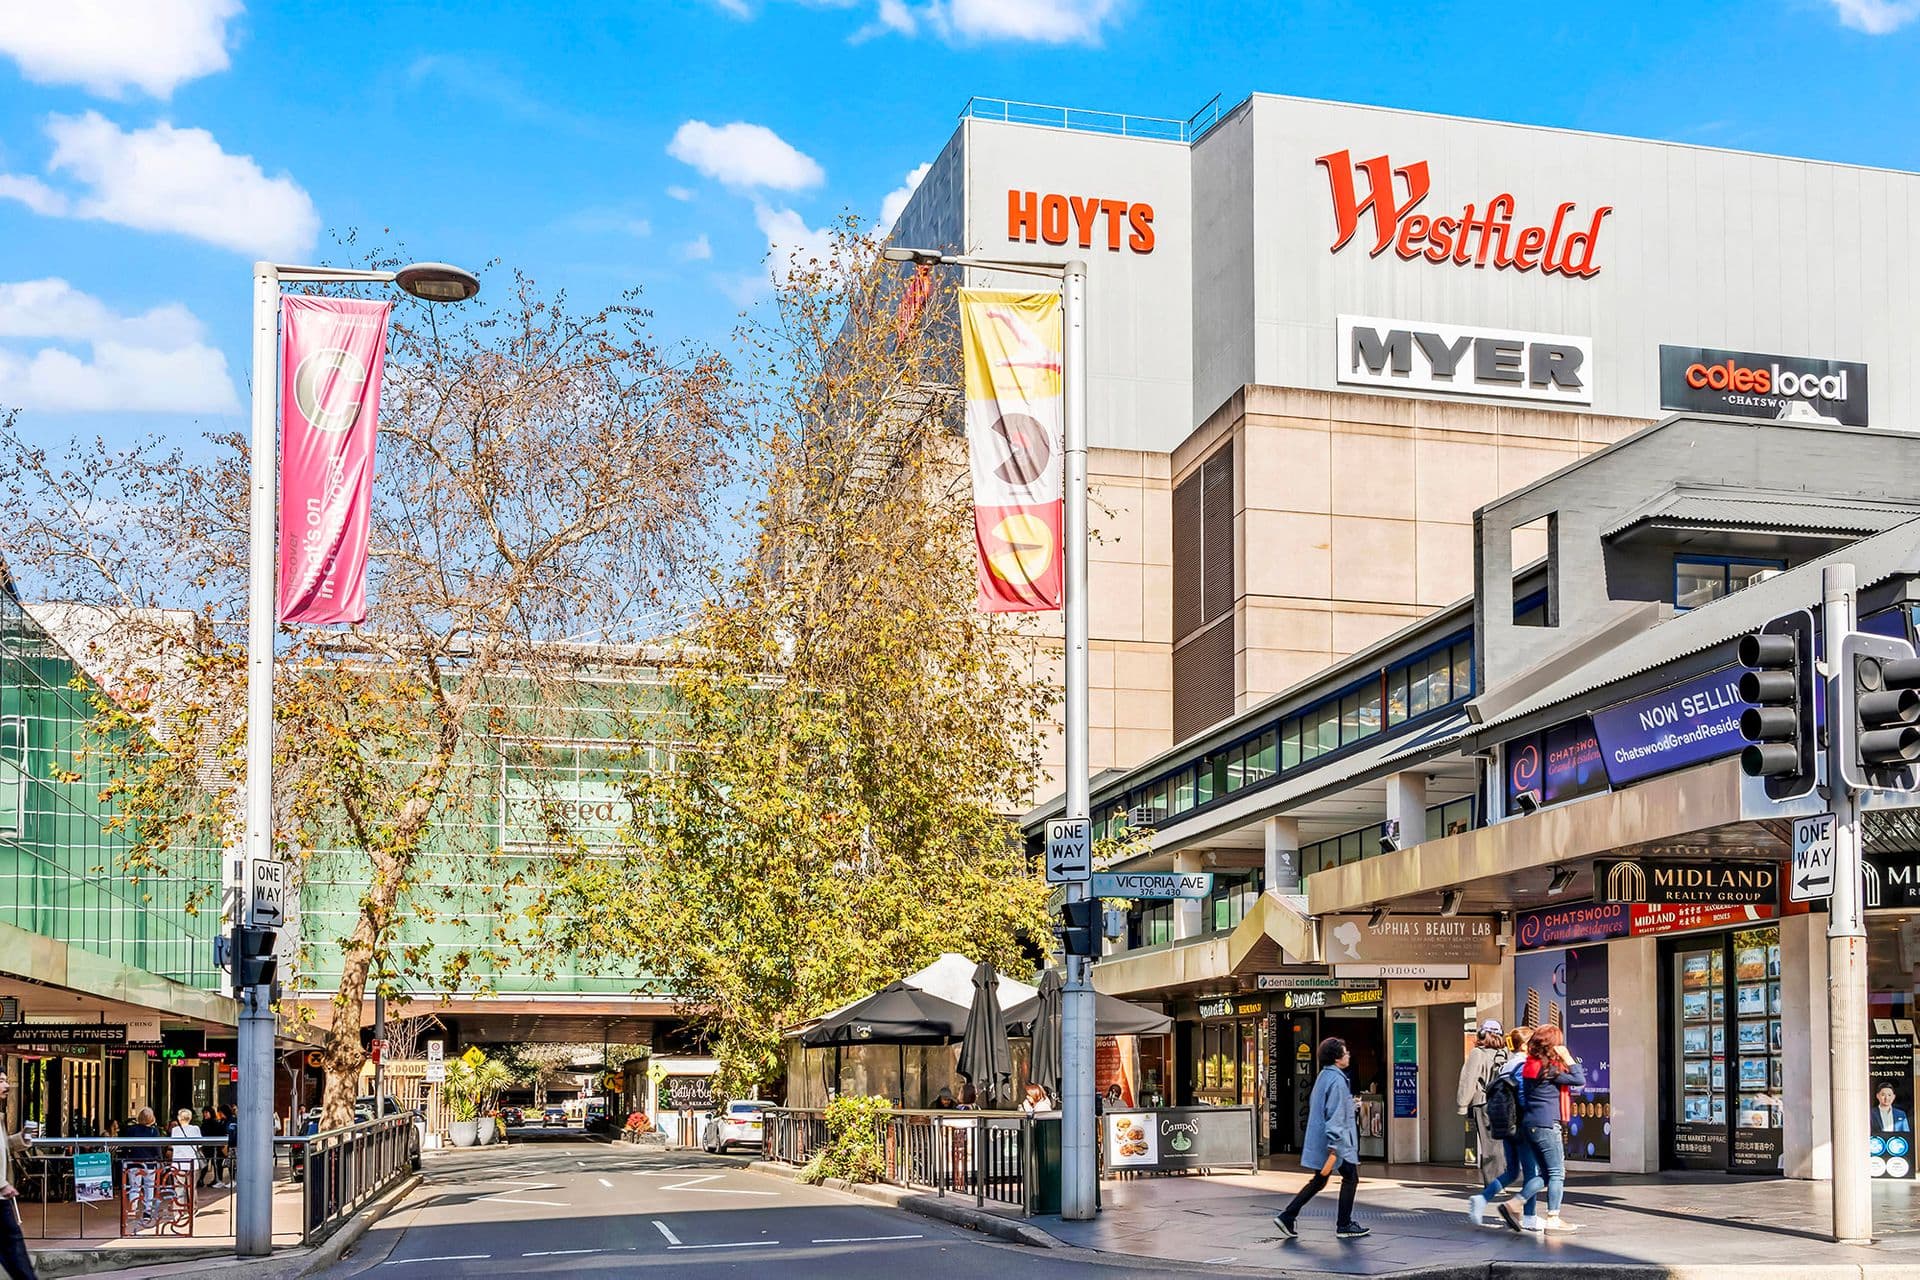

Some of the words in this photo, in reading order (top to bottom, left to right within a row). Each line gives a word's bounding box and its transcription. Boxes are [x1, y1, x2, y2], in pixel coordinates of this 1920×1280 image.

[1008, 190, 1155, 254] HOYTS
[1315, 149, 1613, 281] Westfield
[1352, 326, 1585, 393] MYER
[306, 498, 321, 525] on
[318, 580, 335, 599] in
[1639, 703, 1679, 731] NOW
[1681, 682, 1740, 718] SELLIN
[1614, 716, 1741, 763] ChatswoodGrandReside
[1053, 825, 1083, 840] ONE
[1800, 822, 1830, 844] ONE
[1052, 844, 1084, 858] WAY
[1797, 847, 1831, 869] WAY
[258, 866, 280, 882] ONE
[1654, 869, 1773, 888] MIDLAND
[1116, 876, 1174, 888] VICTORIA
[1180, 877, 1204, 889] AVE
[256, 886, 281, 902] WAY
[1140, 888, 1155, 896] 376
[1165, 888, 1181, 896] 430
[1666, 891, 1712, 900] REALTY
[1718, 892, 1761, 901] GROUP
[1544, 904, 1621, 927] CHATSWOOD
[1634, 912, 1676, 927] MIDLAND
[1426, 922, 1465, 936] BEAUTY
[1472, 922, 1491, 936] LAB
[1542, 924, 1572, 942] Grand
[1573, 921, 1623, 938] Residences
[1380, 967, 1426, 976] ponoco
[1268, 979, 1294, 987] dental
[1295, 979, 1339, 987] confidence
[13, 1030, 70, 1039] ANYTIME
[72, 1030, 124, 1039] FITNESS
[395, 1065, 427, 1073] DOODE
[1395, 1079, 1415, 1087] TAX
[1161, 1118, 1199, 1136] Campos
[1675, 1134, 1687, 1142] FREE
[1687, 1134, 1706, 1142] MARKET
